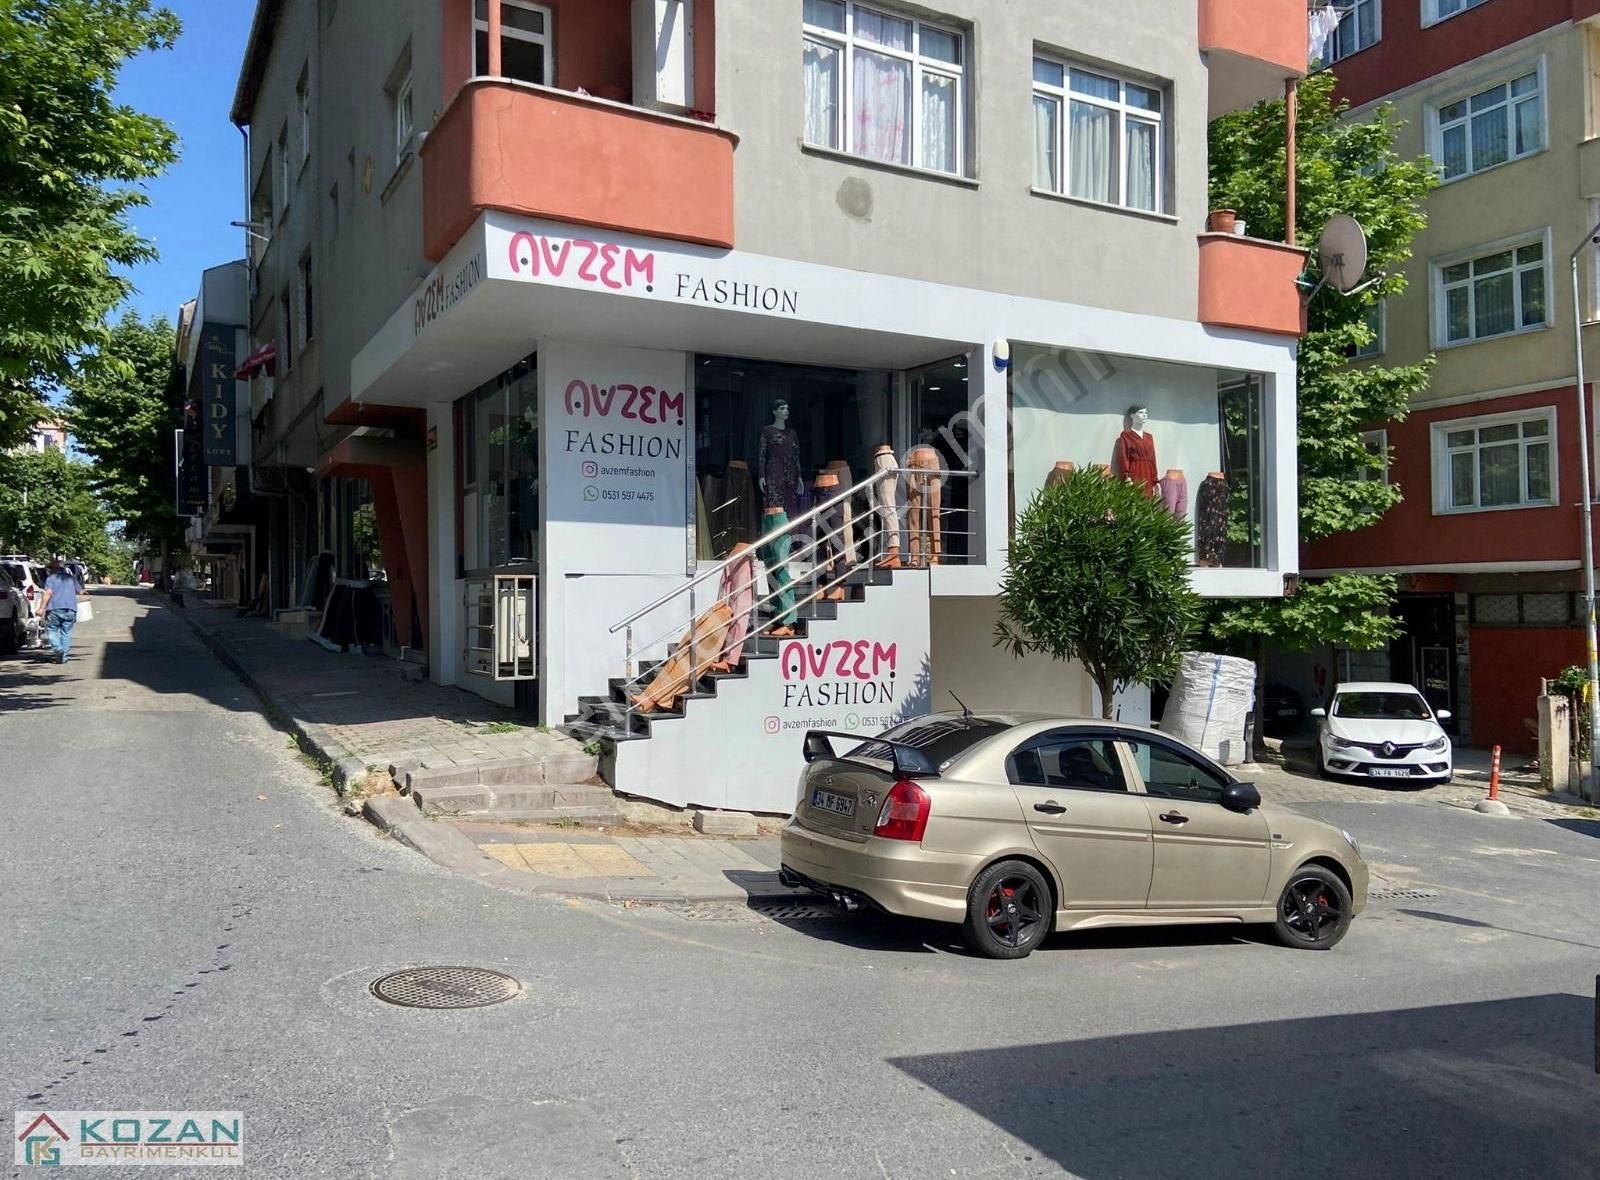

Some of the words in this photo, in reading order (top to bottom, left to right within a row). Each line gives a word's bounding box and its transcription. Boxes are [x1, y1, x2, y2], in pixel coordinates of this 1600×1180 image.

[509, 230, 655, 293] AVZEM
[675, 273, 799, 314] FASHION
[415, 274, 444, 336] AVZEM
[445, 252, 480, 310] FASHION
[210, 363, 228, 439] KIDY
[564, 379, 684, 426] AVZEM
[565, 430, 681, 459] FASHION
[601, 465, 655, 477] avzemfashion
[602, 490, 619, 500] 0531
[621, 491, 635, 501] 597
[636, 492, 655, 501] 4475
[782, 640, 897, 680] AVZEM
[784, 681, 894, 707] FASHION
[783, 717, 837, 729] avzemfashion
[862, 717, 878, 727] 0531
